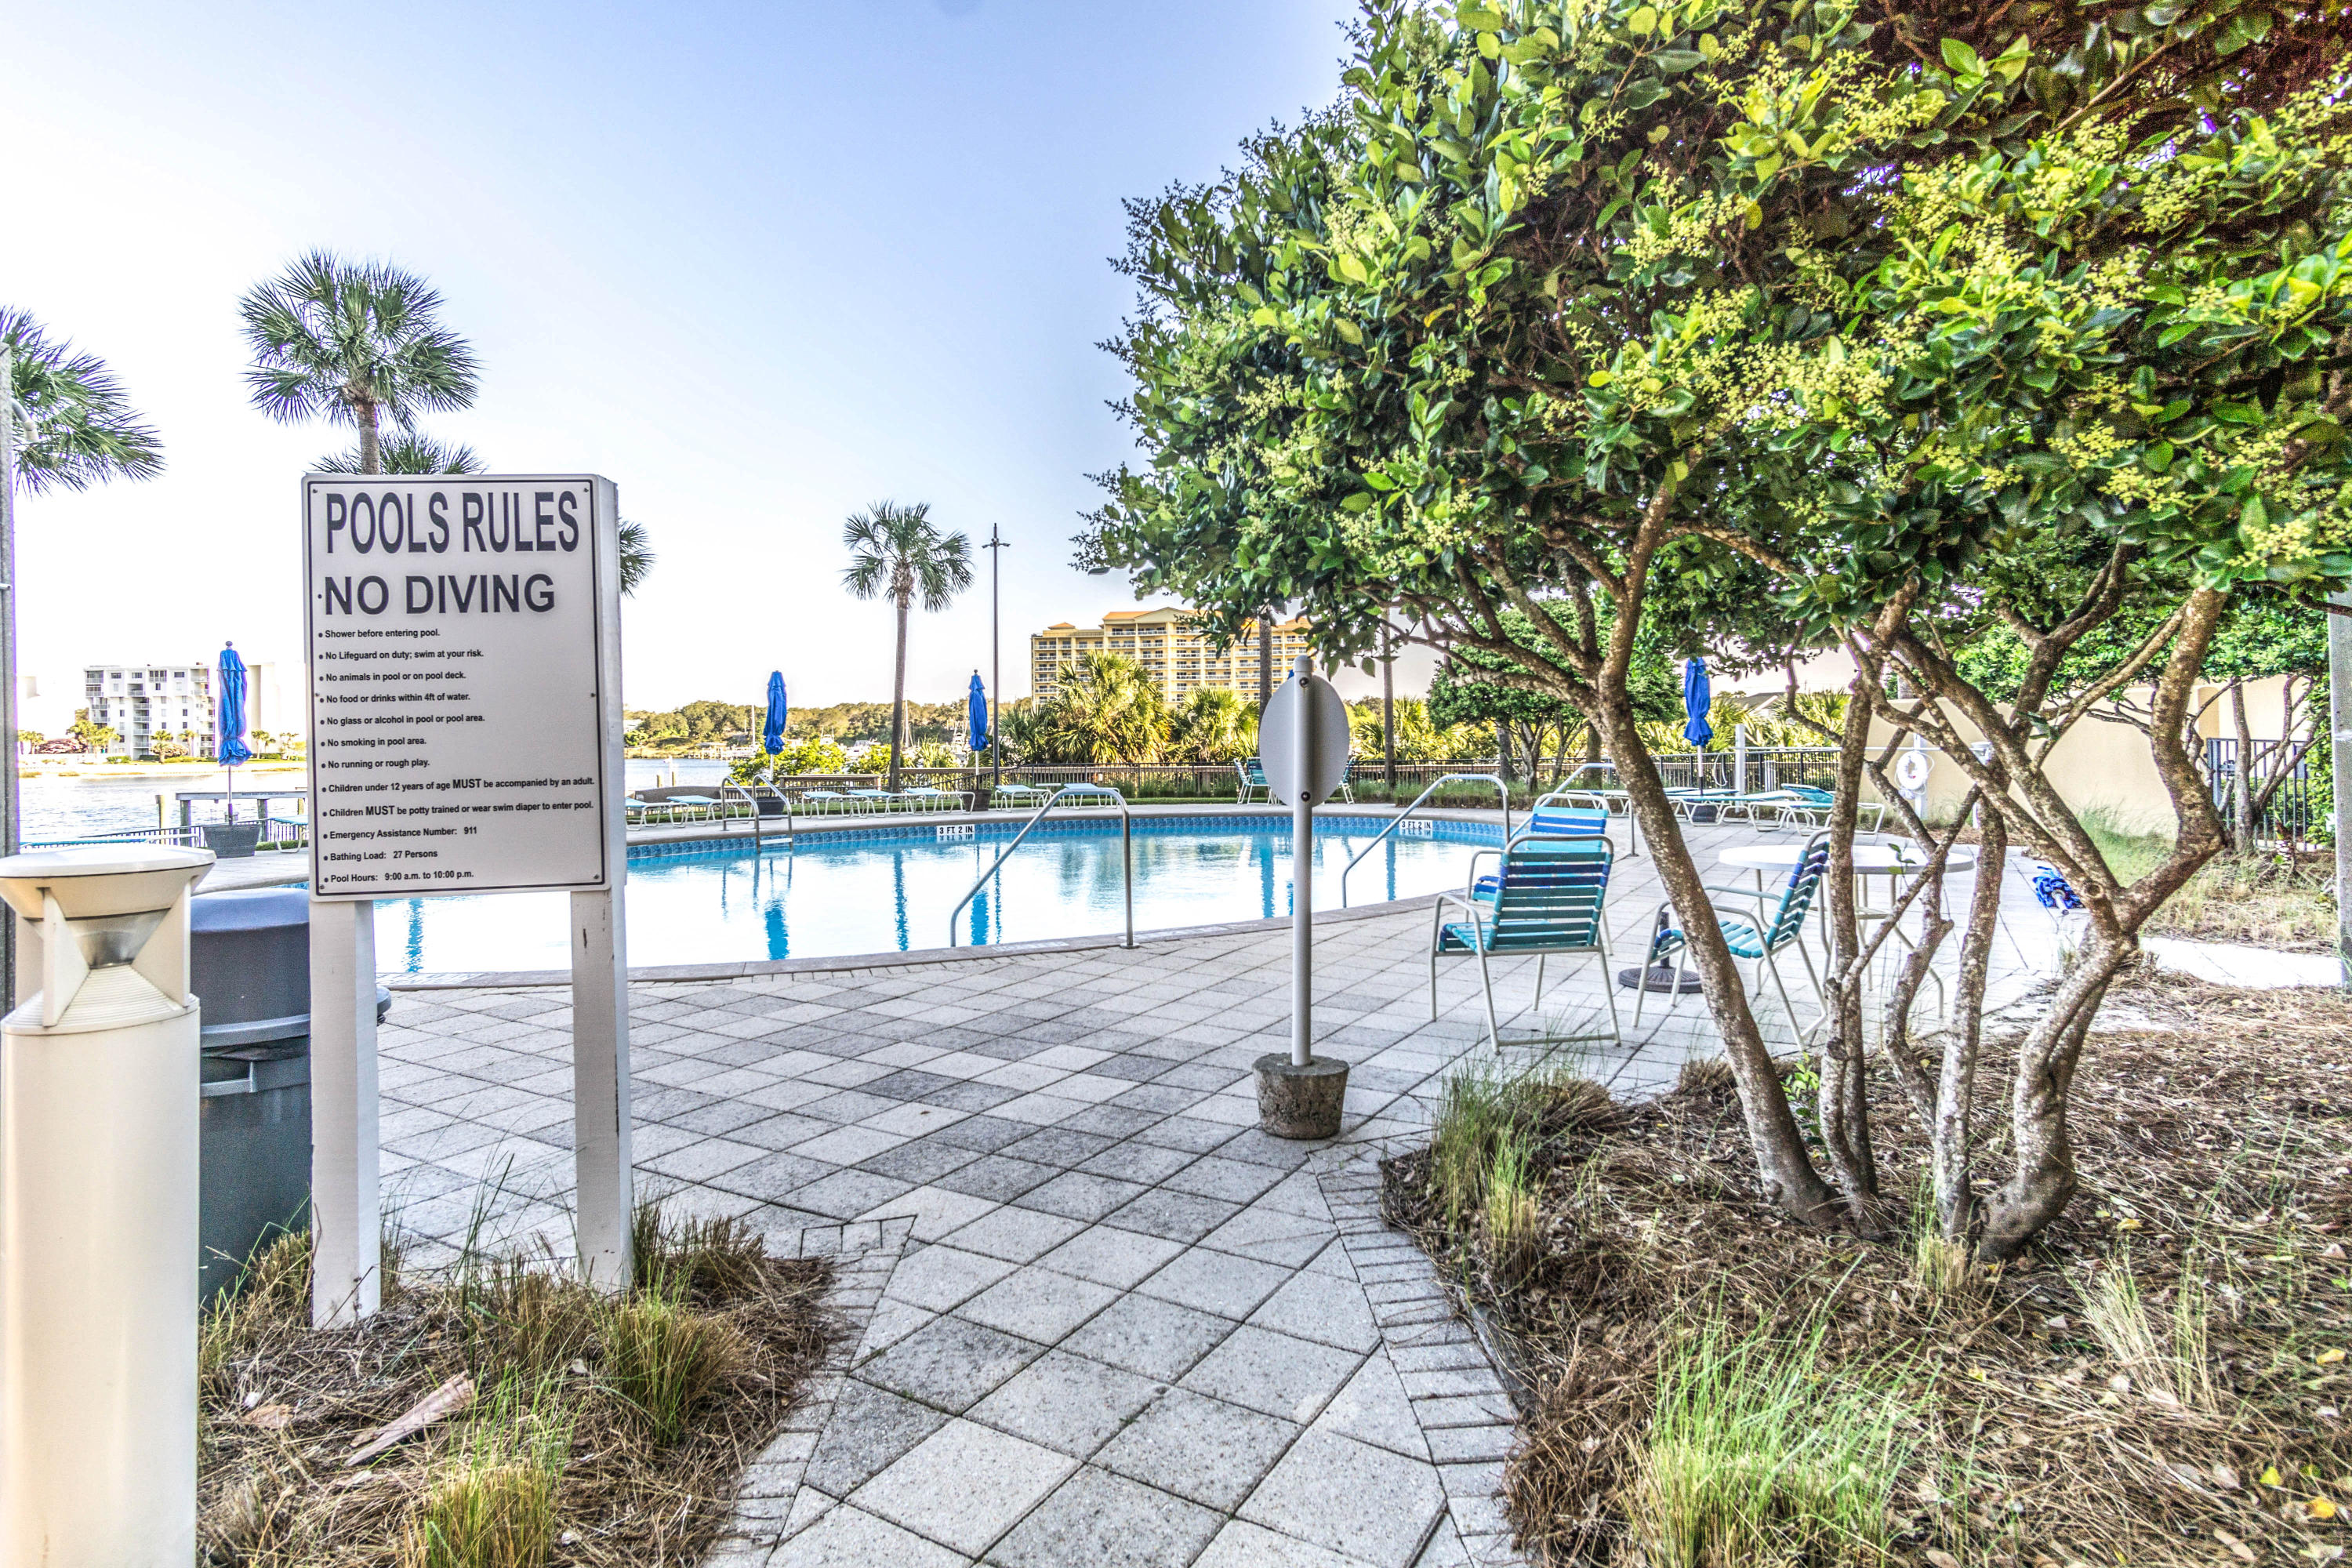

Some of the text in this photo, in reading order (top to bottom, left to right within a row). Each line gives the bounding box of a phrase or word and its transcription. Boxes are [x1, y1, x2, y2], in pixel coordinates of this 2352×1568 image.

[326, 491, 579, 554] POOLS RULES
[325, 573, 554, 615] NO DIVING
[325, 628, 441, 639] Shower before entering pool.
[338, 650, 378, 661] Lifeguard
[390, 650, 412, 660] duty;
[413, 649, 435, 659] swim
[436, 649, 445, 658] at
[445, 651, 466, 659] your
[466, 648, 484, 657] risk.
[325, 673, 337, 681] No
[339, 672, 371, 681] animals
[372, 672, 380, 681] in
[382, 672, 401, 682] pool
[424, 670, 443, 681] pool
[444, 670, 466, 679] deck.
[326, 695, 338, 703] No
[339, 694, 358, 703] food
[370, 693, 397, 702] drinks
[397, 692, 423, 702] within
[423, 692, 435, 701] 4ft
[436, 692, 445, 701] of
[445, 692, 470, 701] water.
[339, 716, 362, 727] glass
[374, 714, 405, 724] alcohol
[415, 714, 434, 724] pool
[445, 713, 464, 724] pool
[327, 738, 339, 746] No
[340, 737, 376, 748] smoking
[377, 737, 386, 746] in
[387, 736, 405, 747] pool
[327, 760, 339, 768] No
[340, 759, 373, 770] running
[385, 758, 409, 768] rough
[410, 757, 430, 768] play.
[328, 783, 363, 793] Children
[365, 782, 389, 791] under
[390, 782, 400, 790] 12
[401, 783, 424, 793] years
[425, 781, 434, 789] of
[435, 782, 451, 791] age
[452, 778, 481, 789] MUST
[483, 779, 493, 788] be
[495, 778, 548, 789] accompanied
[549, 777, 560, 788] by
[572, 776, 595, 786] adult.
[328, 808, 364, 817] Children
[365, 804, 395, 815] MUST
[396, 806, 407, 815] be
[408, 806, 430, 816] potty
[430, 804, 459, 814] trained
[492, 803, 514, 811] swim
[514, 802, 541, 812] diaper
[551, 801, 573, 810] enter
[573, 800, 593, 811] pool.
[1418, 821, 1422, 829] 2
[329, 826, 477, 840] Emergency Assistance Number: 911
[329, 849, 438, 862] Bathing Load: 27 Persons
[330, 873, 349, 883] Pool
[350, 873, 378, 882] Hours:
[383, 872, 402, 880] 9:00
[422, 871, 431, 880] to
[433, 869, 455, 879] 10:00
[456, 870, 474, 880] p.m.
